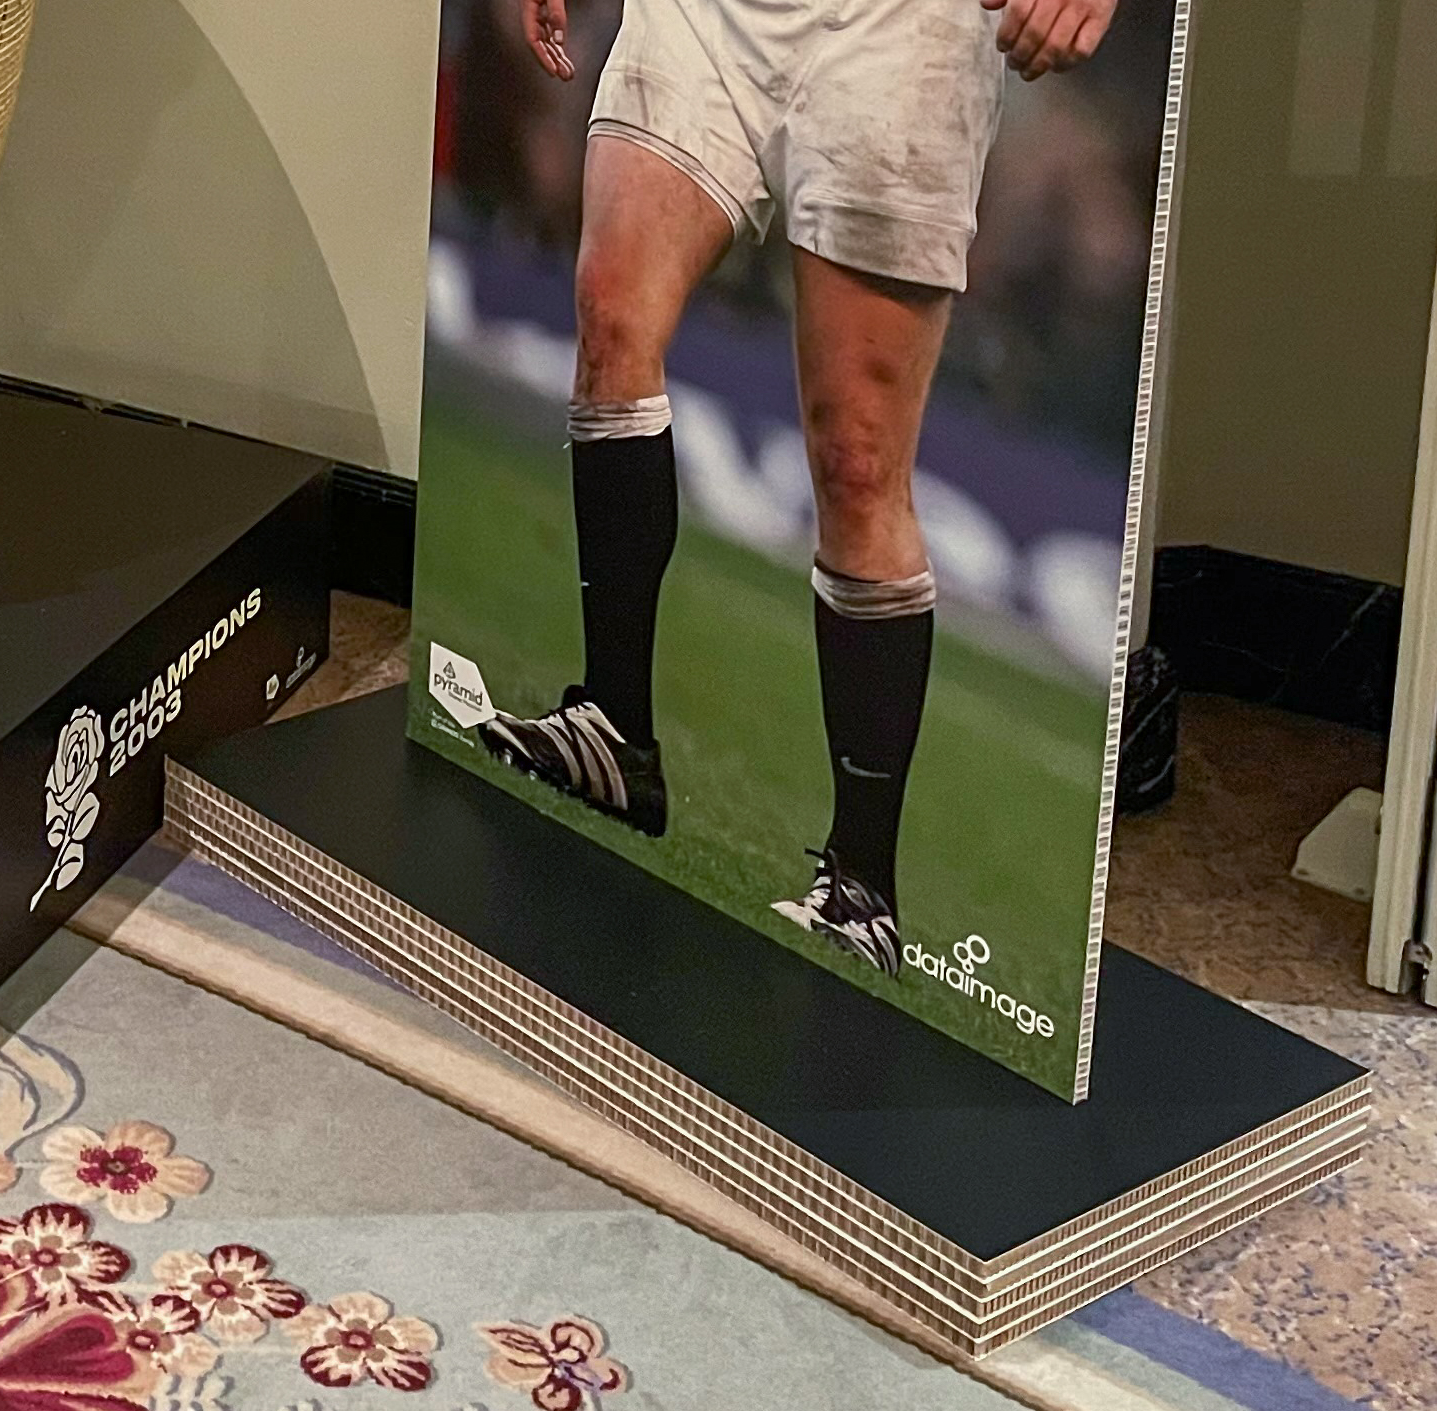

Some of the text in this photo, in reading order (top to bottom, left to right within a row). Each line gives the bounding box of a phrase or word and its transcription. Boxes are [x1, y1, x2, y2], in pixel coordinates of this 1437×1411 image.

[109, 588, 261, 742] CHAMPIONS
[109, 689, 182, 777] 2003
[902, 942, 1055, 1038] dataimage
